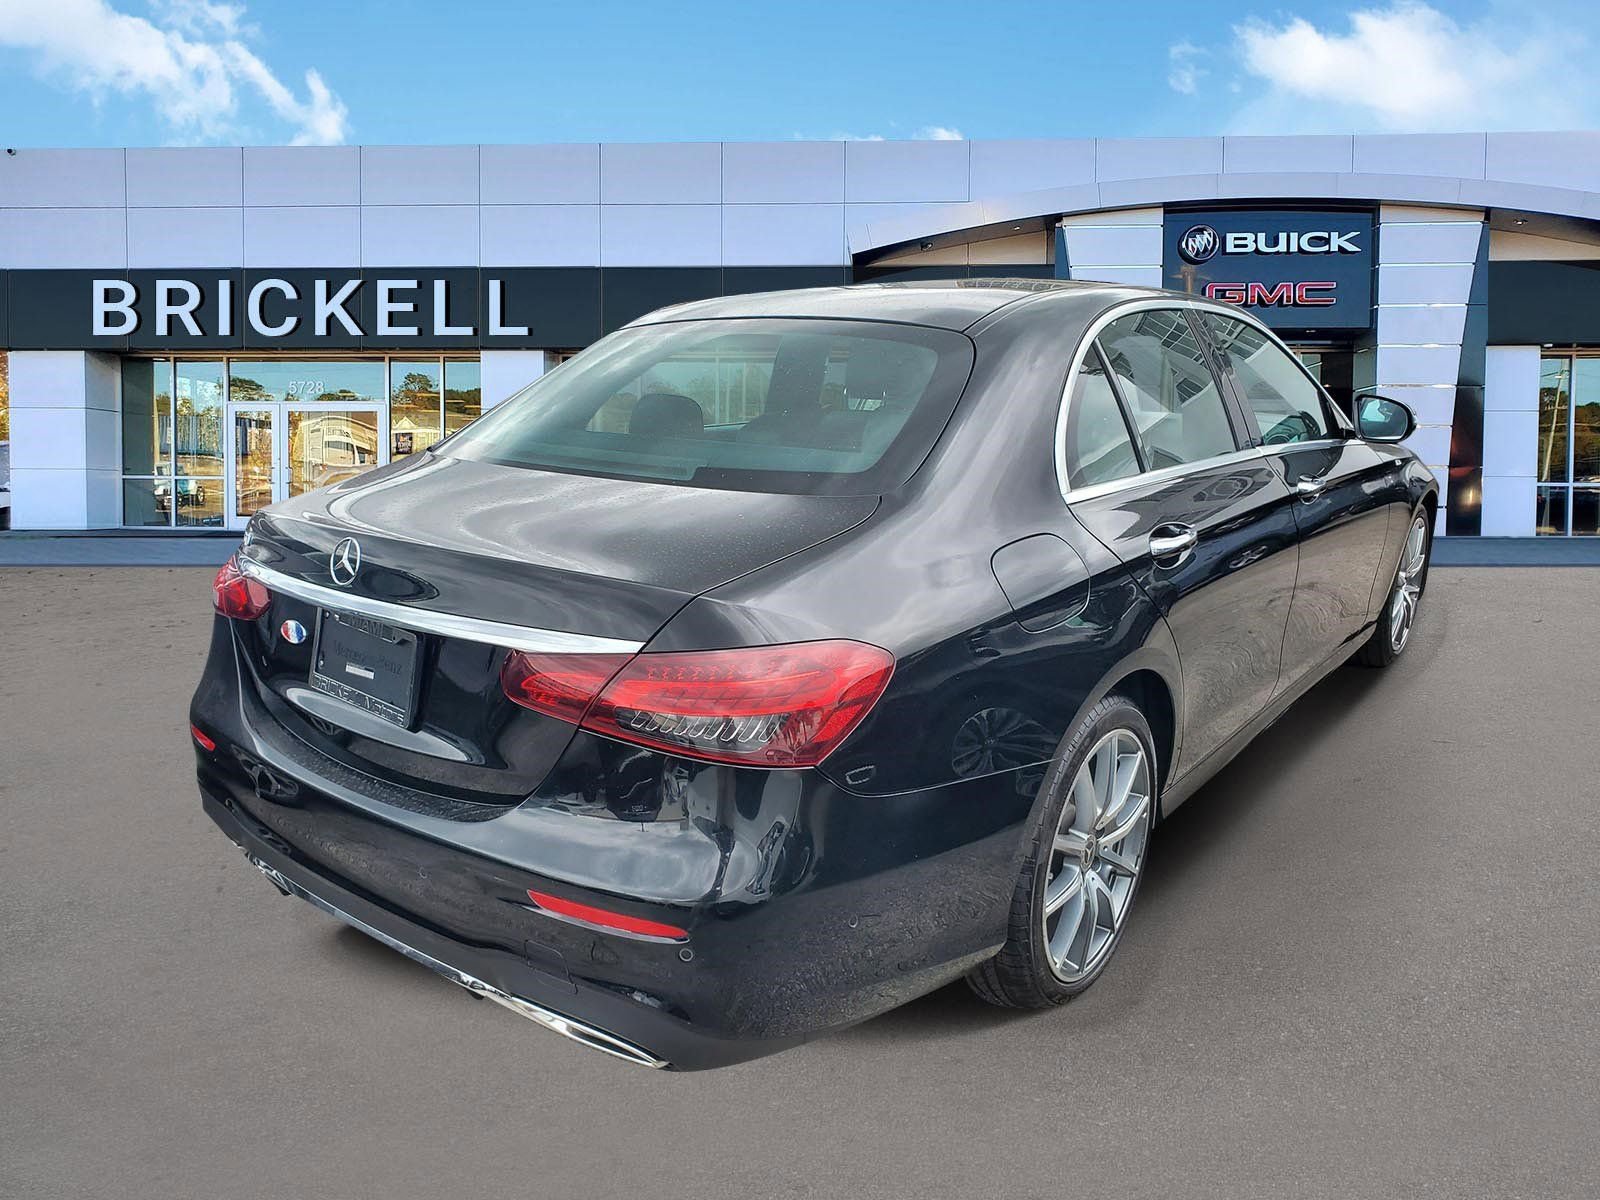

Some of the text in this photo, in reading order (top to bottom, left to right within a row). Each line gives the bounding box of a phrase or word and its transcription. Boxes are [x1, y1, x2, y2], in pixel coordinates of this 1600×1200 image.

[1226, 231, 1361, 252] BUICK
[1205, 282, 1337, 304] GMC
[91, 278, 530, 337] BRICKELL
[289, 381, 324, 394] 5728
